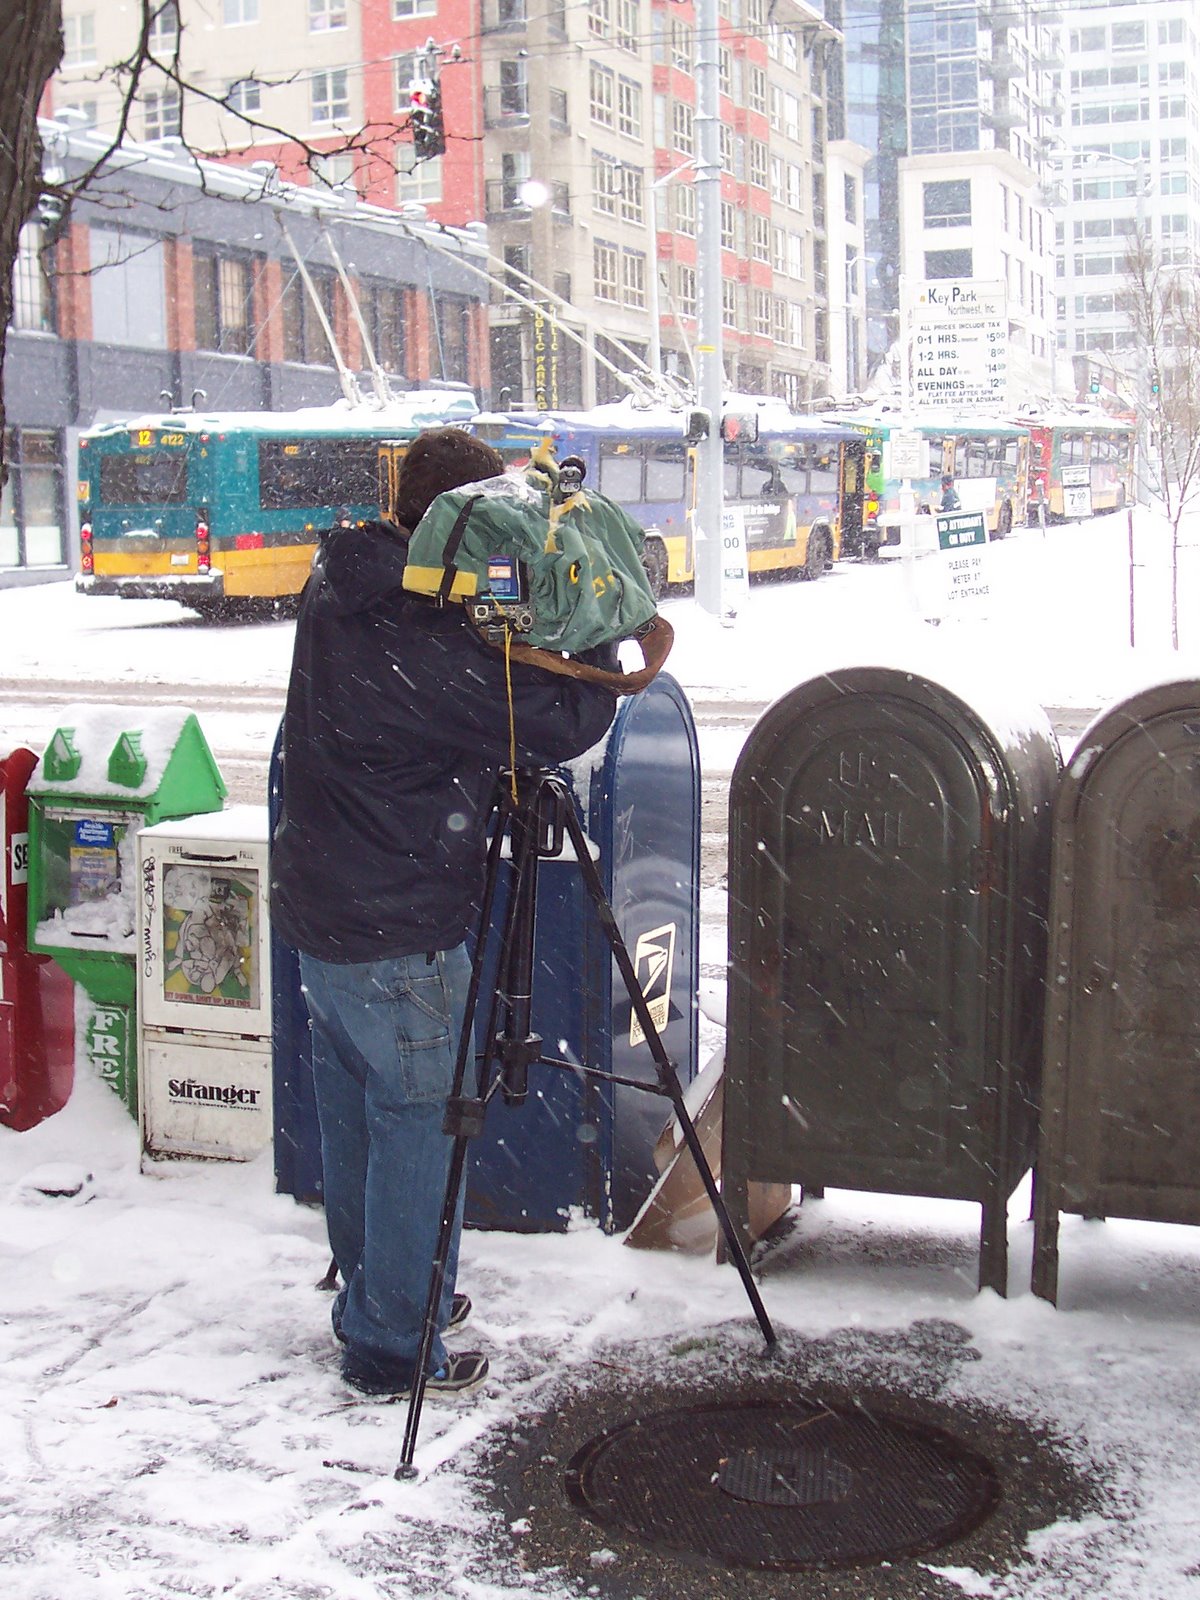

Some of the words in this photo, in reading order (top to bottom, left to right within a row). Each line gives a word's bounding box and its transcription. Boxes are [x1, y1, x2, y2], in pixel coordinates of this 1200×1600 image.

[928, 288, 949, 306] Key
[952, 287, 977, 302] Park
[938, 334, 960, 343] HRS.
[938, 350, 959, 359] HRS.
[917, 368, 934, 377] ALL
[940, 367, 958, 376] DAY
[536, 356, 548, 410] PARKNG
[917, 380, 965, 391] EVENINGS
[138, 430, 151, 446] 12
[160, 433, 184, 446] 4122
[959, 531, 976, 544] DUTY
[948, 559, 969, 570] PLEASE
[972, 558, 982, 567] PAY
[948, 590, 958, 600] LOT
[961, 585, 990, 598] ENTRANCE
[168, 846, 183, 854] FREE
[92, 1012, 120, 1092] FRE
[168, 1079, 261, 1105] Stranger
